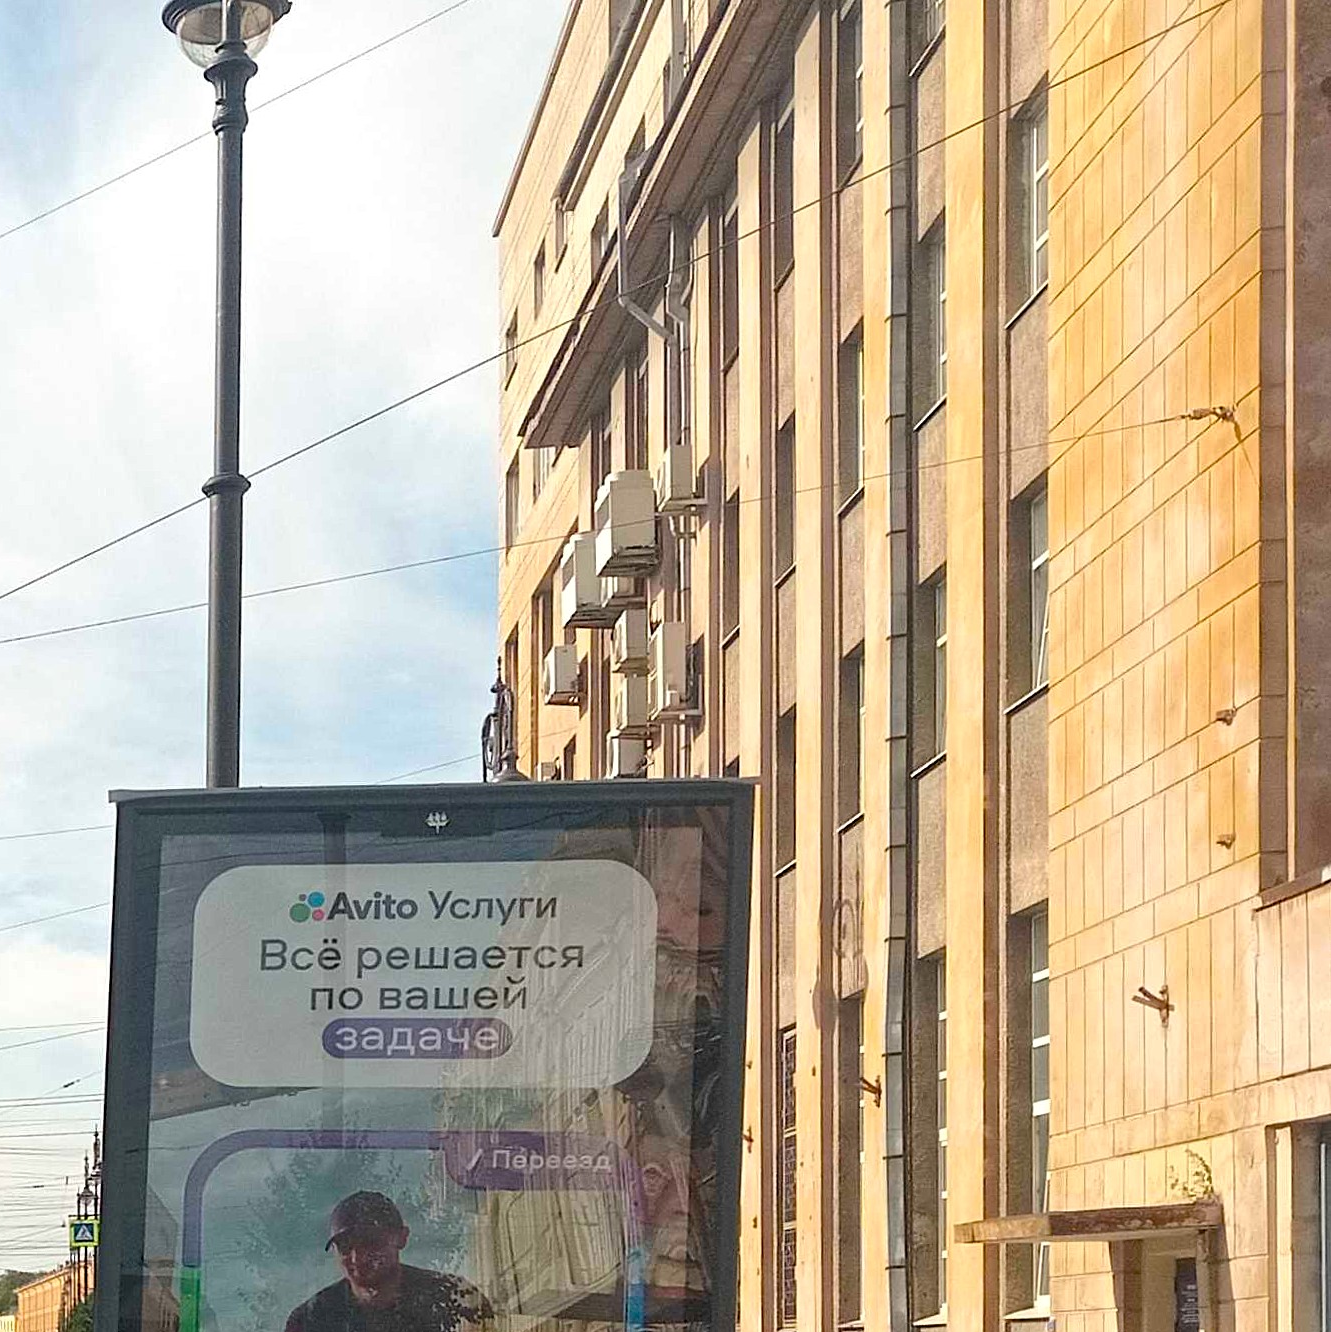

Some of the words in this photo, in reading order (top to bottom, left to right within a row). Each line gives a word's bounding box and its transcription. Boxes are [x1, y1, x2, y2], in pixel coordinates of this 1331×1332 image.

[327, 891, 418, 921] Avito
[428, 890, 558, 926] Услуги
[260, 938, 342, 972] Всё
[357, 944, 584, 978] решается
[310, 986, 364, 1012] по
[379, 975, 527, 1011] вашей
[335, 1026, 500, 1056] задаче
[493, 1149, 613, 1172] Переезд
